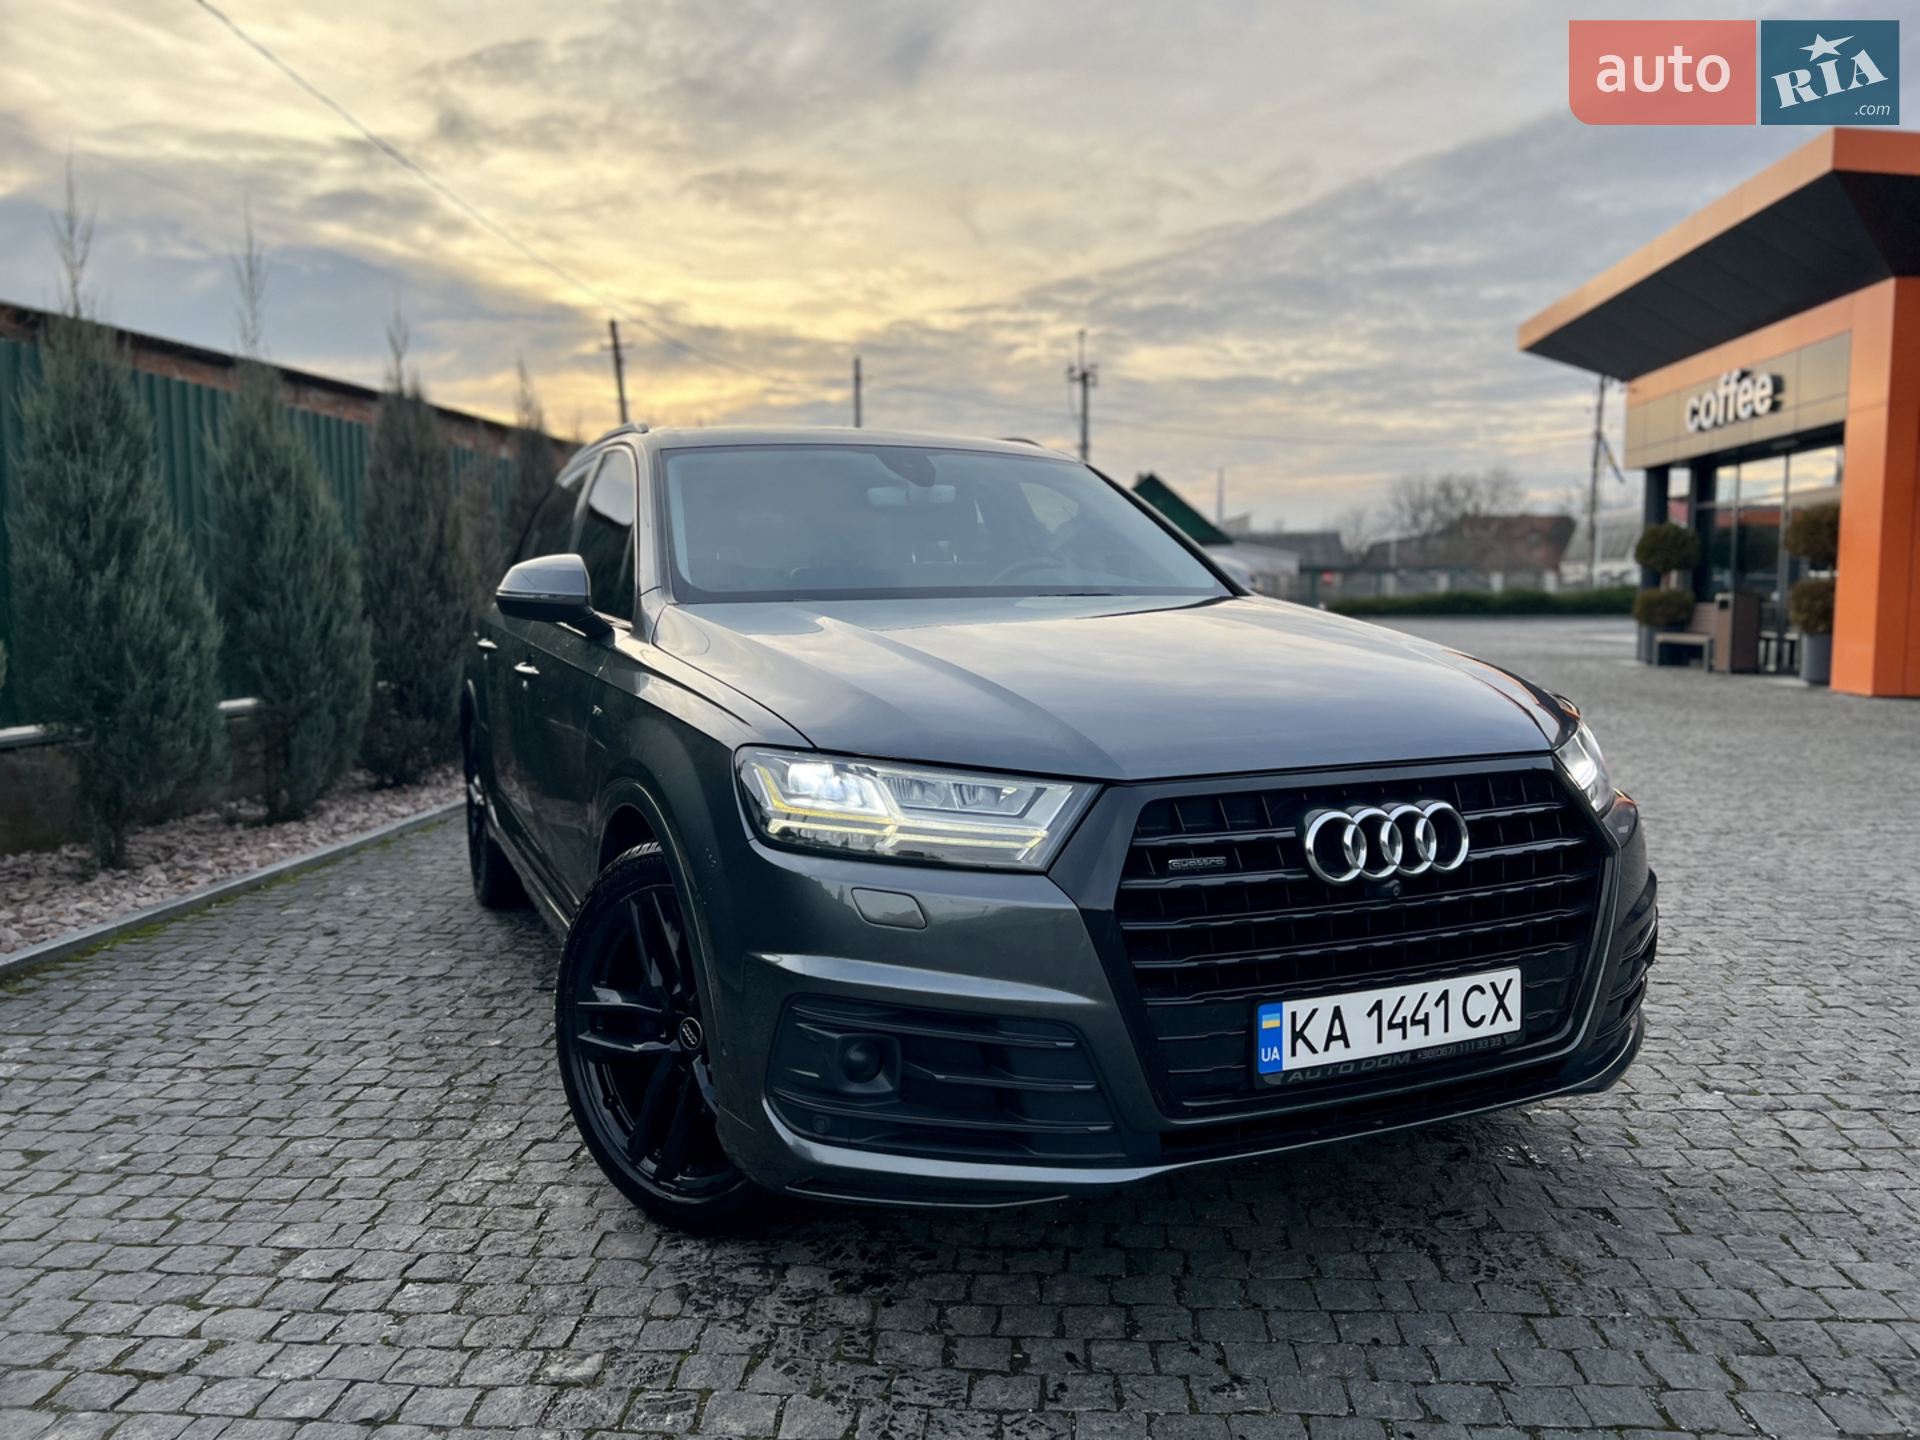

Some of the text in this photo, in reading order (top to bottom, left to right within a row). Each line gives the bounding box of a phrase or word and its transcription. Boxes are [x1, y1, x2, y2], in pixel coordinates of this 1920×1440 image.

[1685, 368, 1774, 433] coffee
[596, 856, 662, 894] BRIDGESTON
[1171, 859, 1224, 868] quattro
[1290, 978, 1513, 1057] KA 1441 CX
[1261, 1047, 1280, 1062] UA
[1287, 1063, 1354, 1083] AUTO
[1360, 1053, 1411, 1071] DOM
